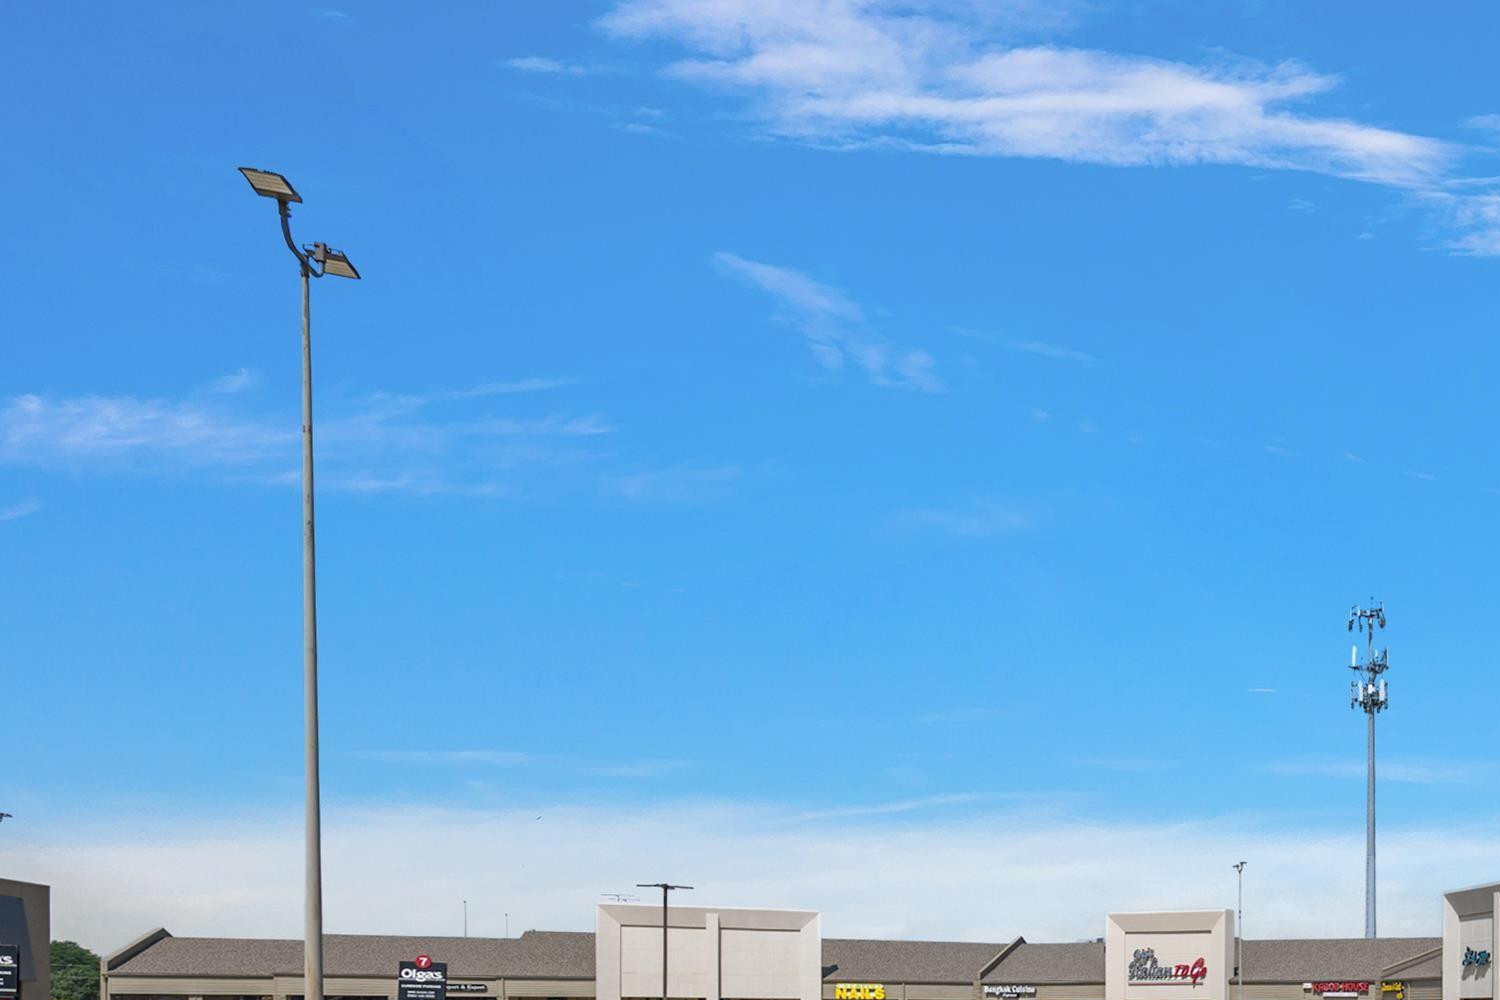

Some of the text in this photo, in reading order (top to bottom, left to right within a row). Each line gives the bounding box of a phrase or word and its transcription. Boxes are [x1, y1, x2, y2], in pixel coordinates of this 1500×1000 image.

[419, 957, 429, 967] 7
[984, 985, 1035, 995] Bangkok Cuisine
[1312, 982, 1340, 993] KABOB
[1341, 981, 1369, 992] HOUSE
[835, 988, 885, 1000] NAILS
